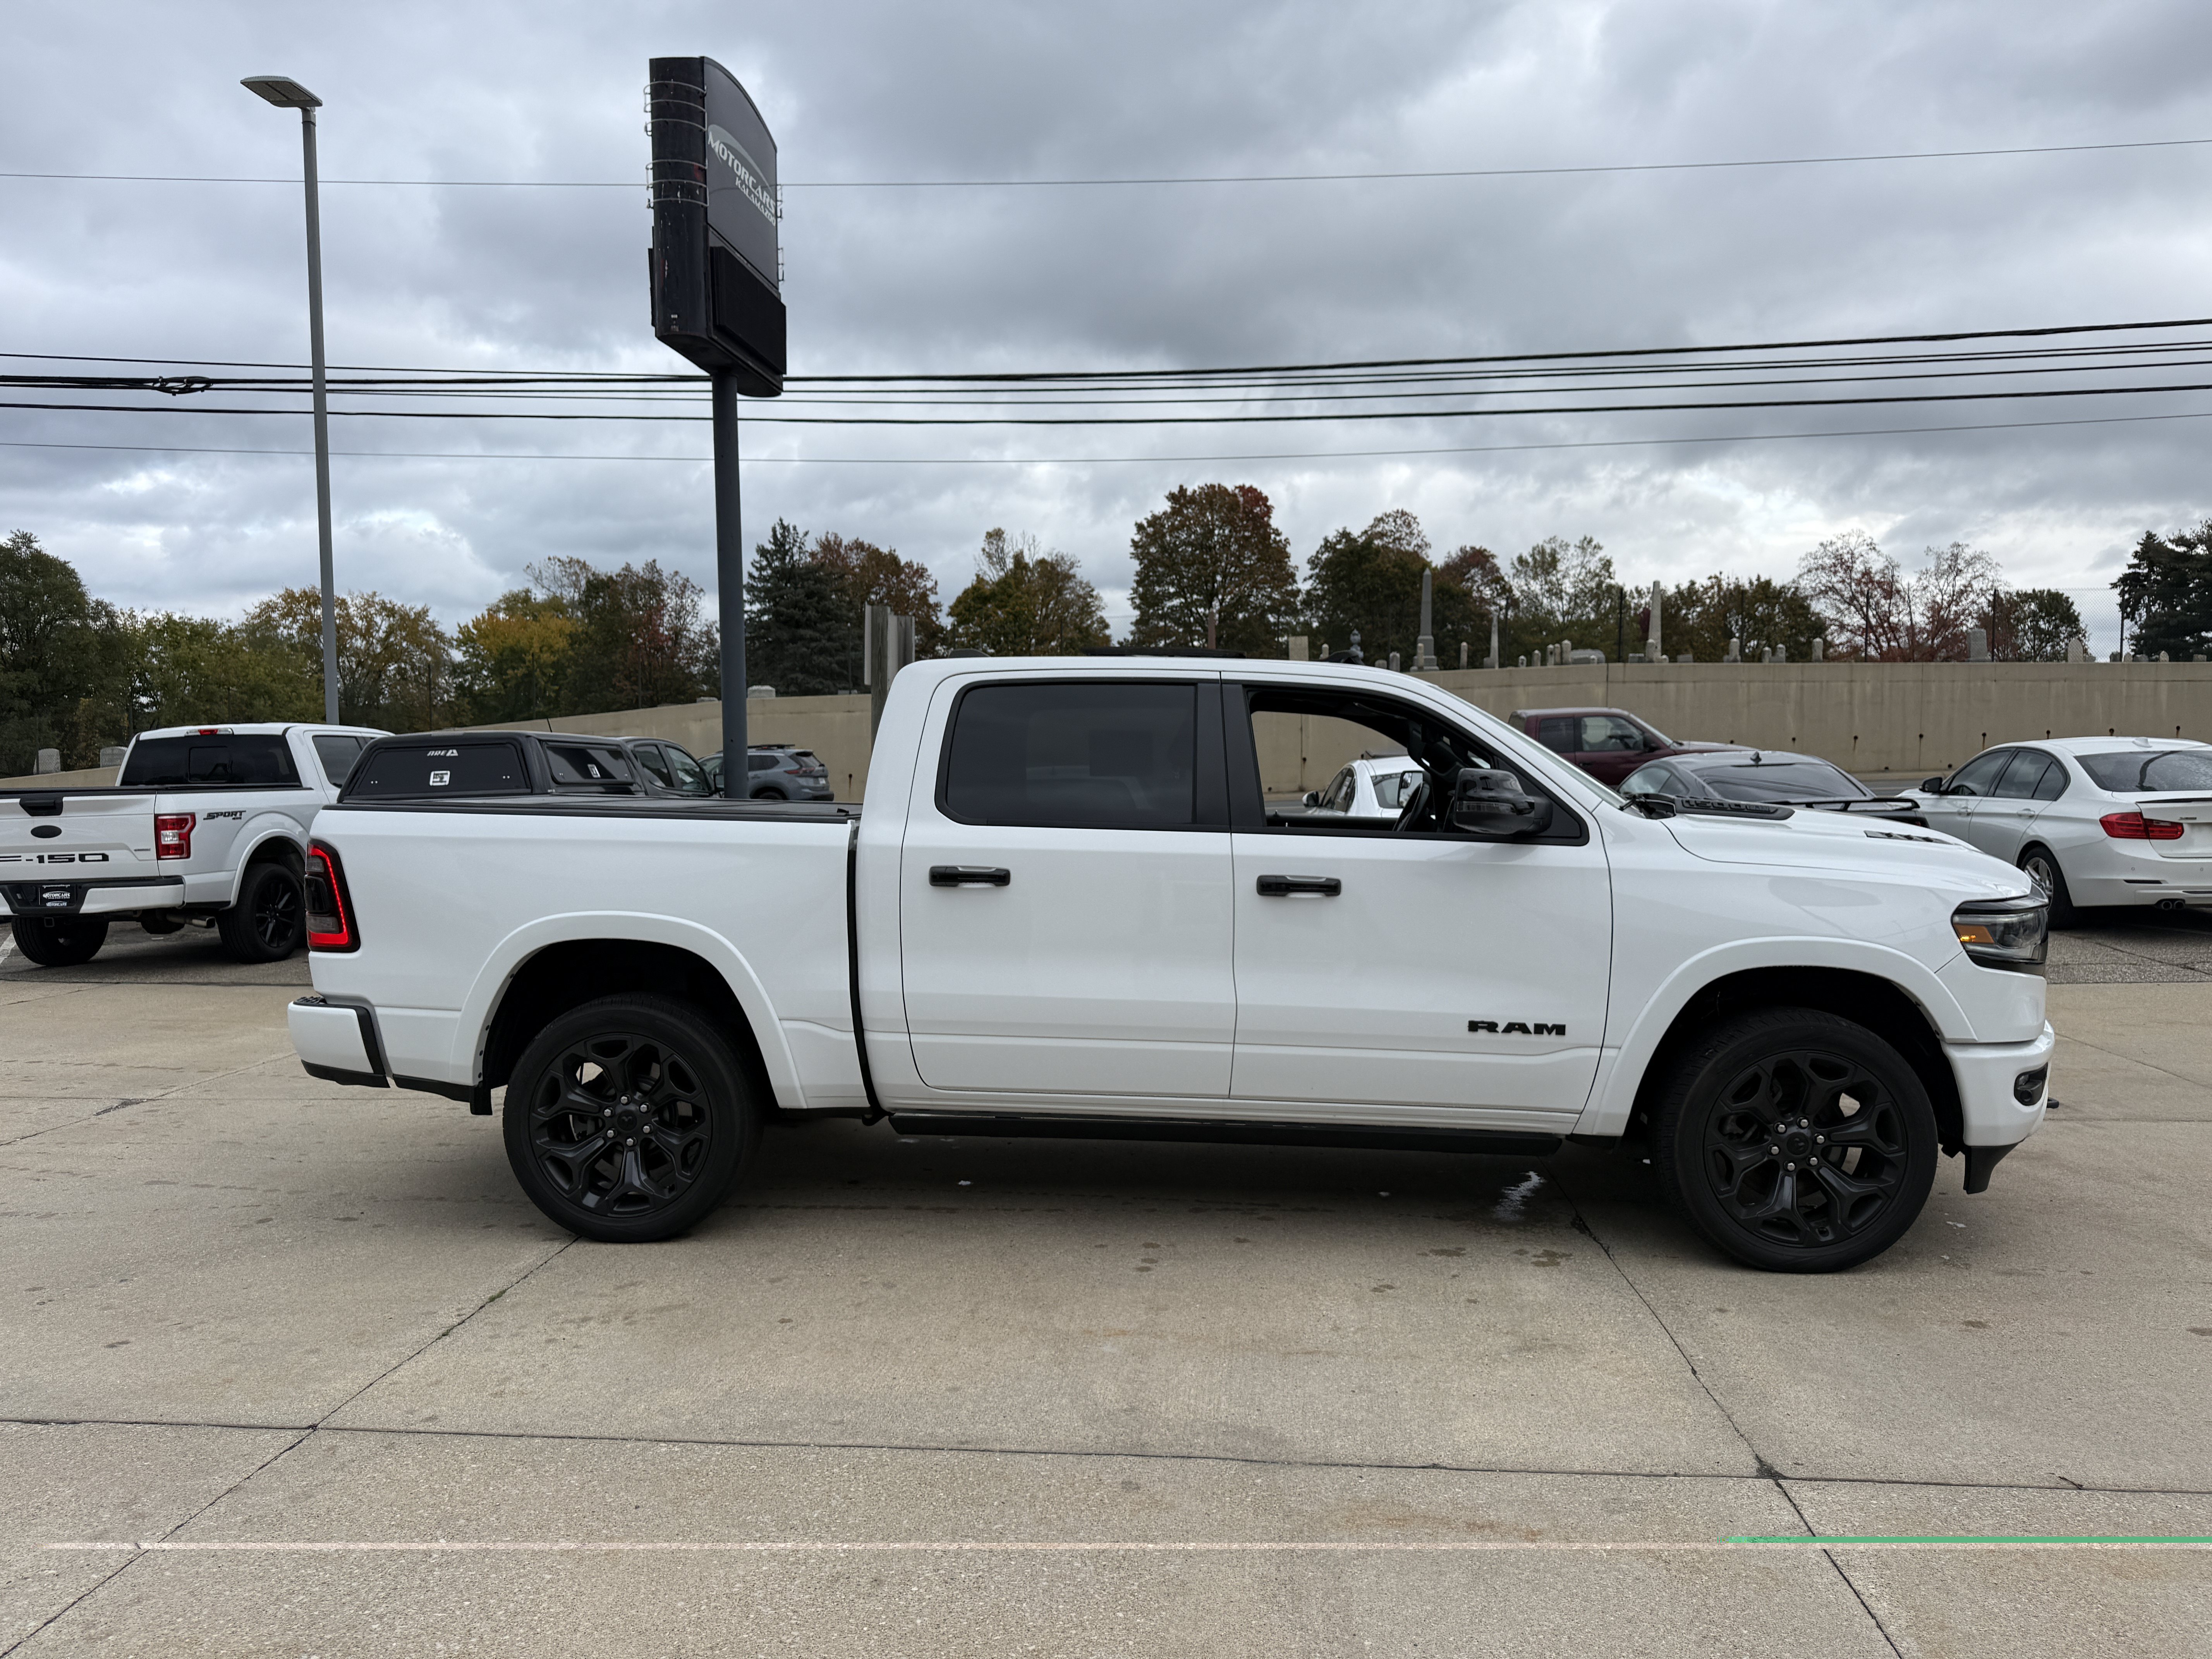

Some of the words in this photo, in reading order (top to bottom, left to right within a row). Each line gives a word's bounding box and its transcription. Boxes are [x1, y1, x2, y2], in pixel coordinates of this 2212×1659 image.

[708, 131, 776, 214] MOTORCARS
[735, 177, 776, 227] KALAMAZOO
[203, 811, 246, 820] SPORT
[1468, 1020, 1566, 1036] RAM
